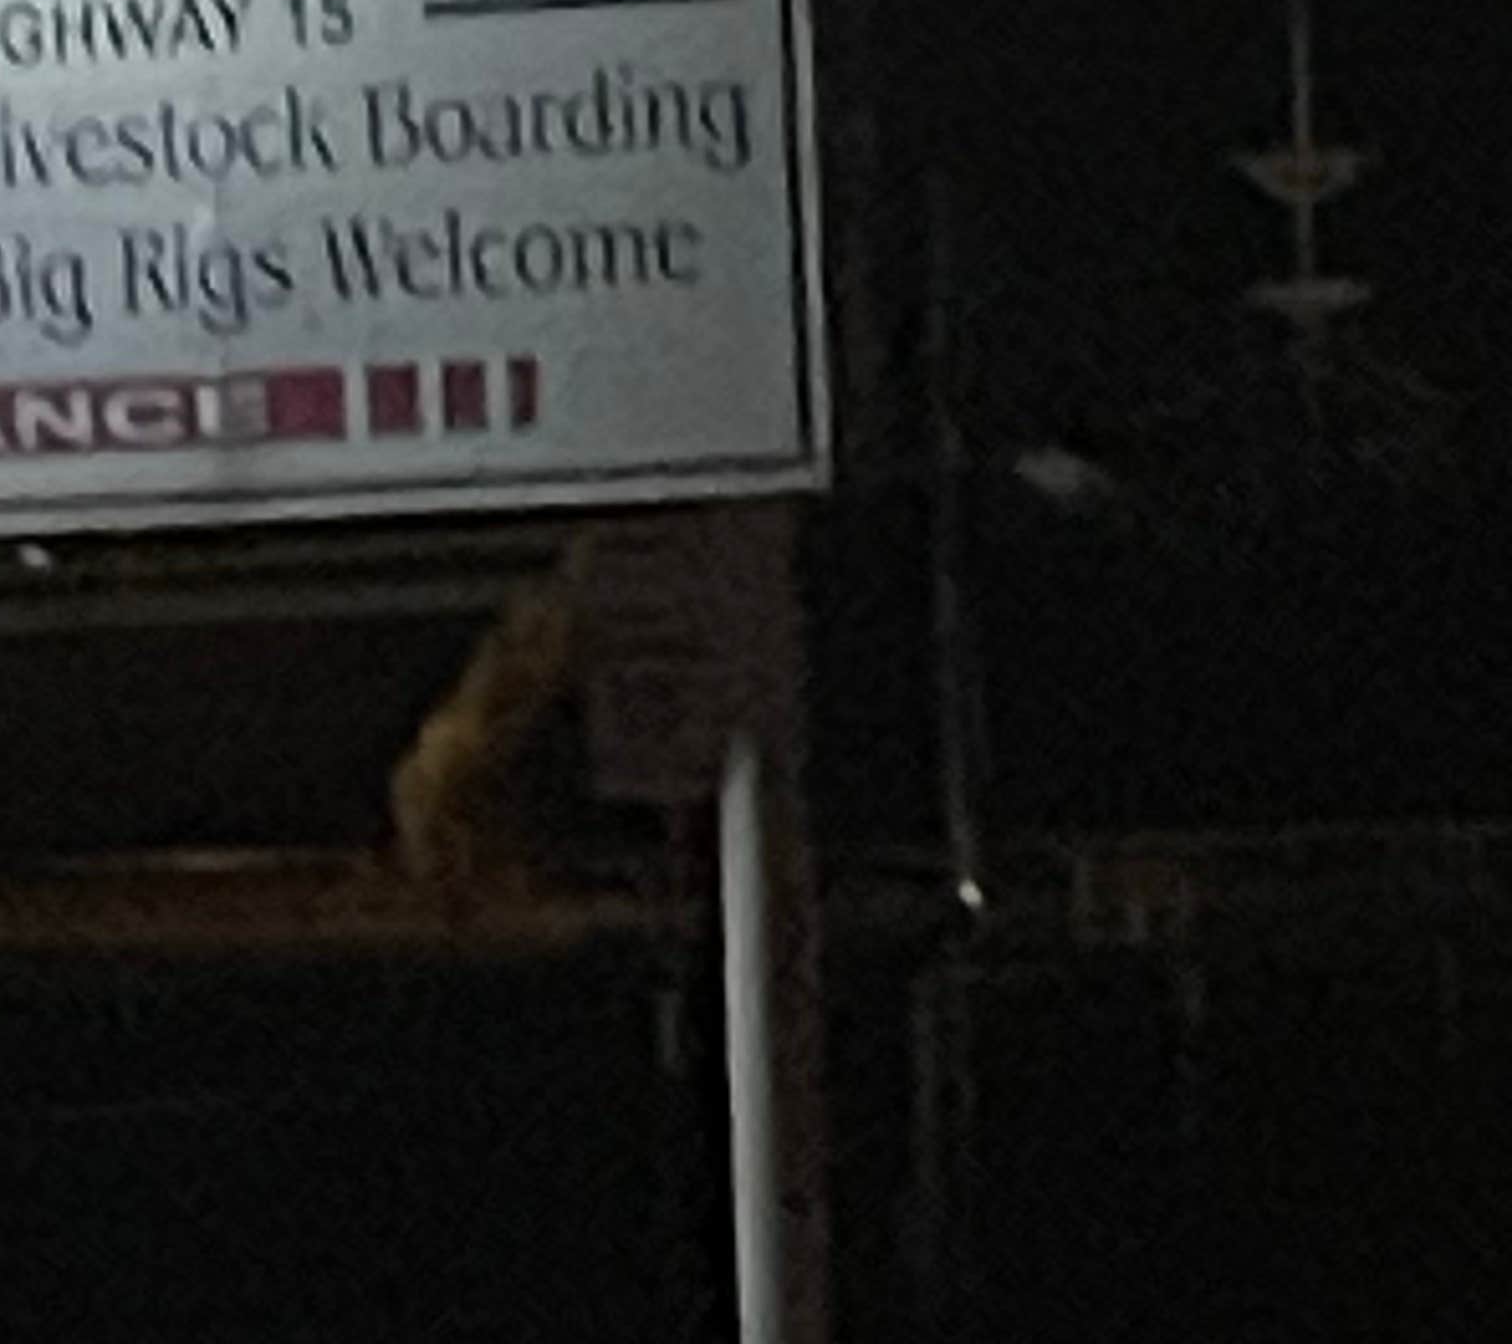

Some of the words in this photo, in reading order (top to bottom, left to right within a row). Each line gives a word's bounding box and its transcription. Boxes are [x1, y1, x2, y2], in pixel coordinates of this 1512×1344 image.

[363, 64, 753, 173] Boarding
[118, 220, 292, 338] Rigs
[322, 208, 703, 303] Welcome
